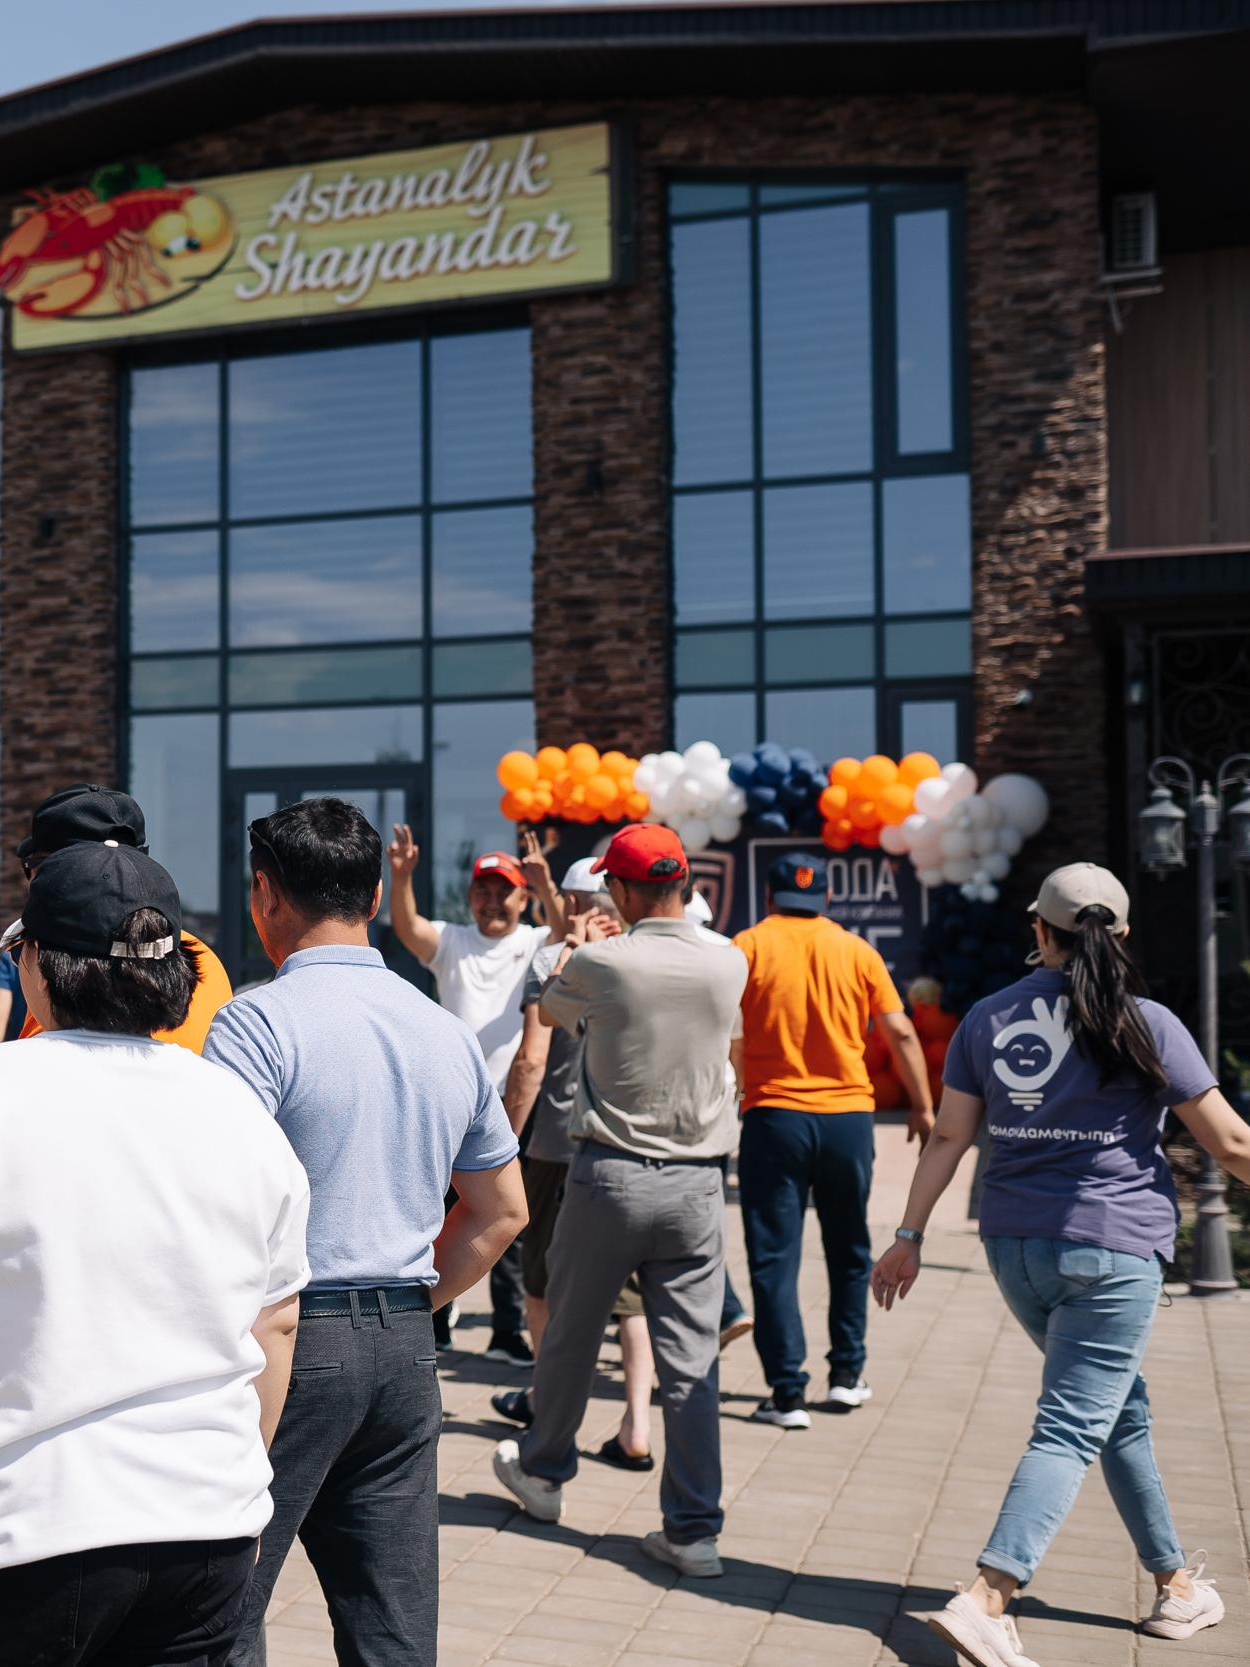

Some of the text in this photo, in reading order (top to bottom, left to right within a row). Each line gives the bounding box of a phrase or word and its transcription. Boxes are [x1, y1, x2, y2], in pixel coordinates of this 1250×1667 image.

[268, 136, 550, 226] Astanalyk
[235, 206, 576, 304] Shayandar
[826, 858, 898, 902] ОДА
